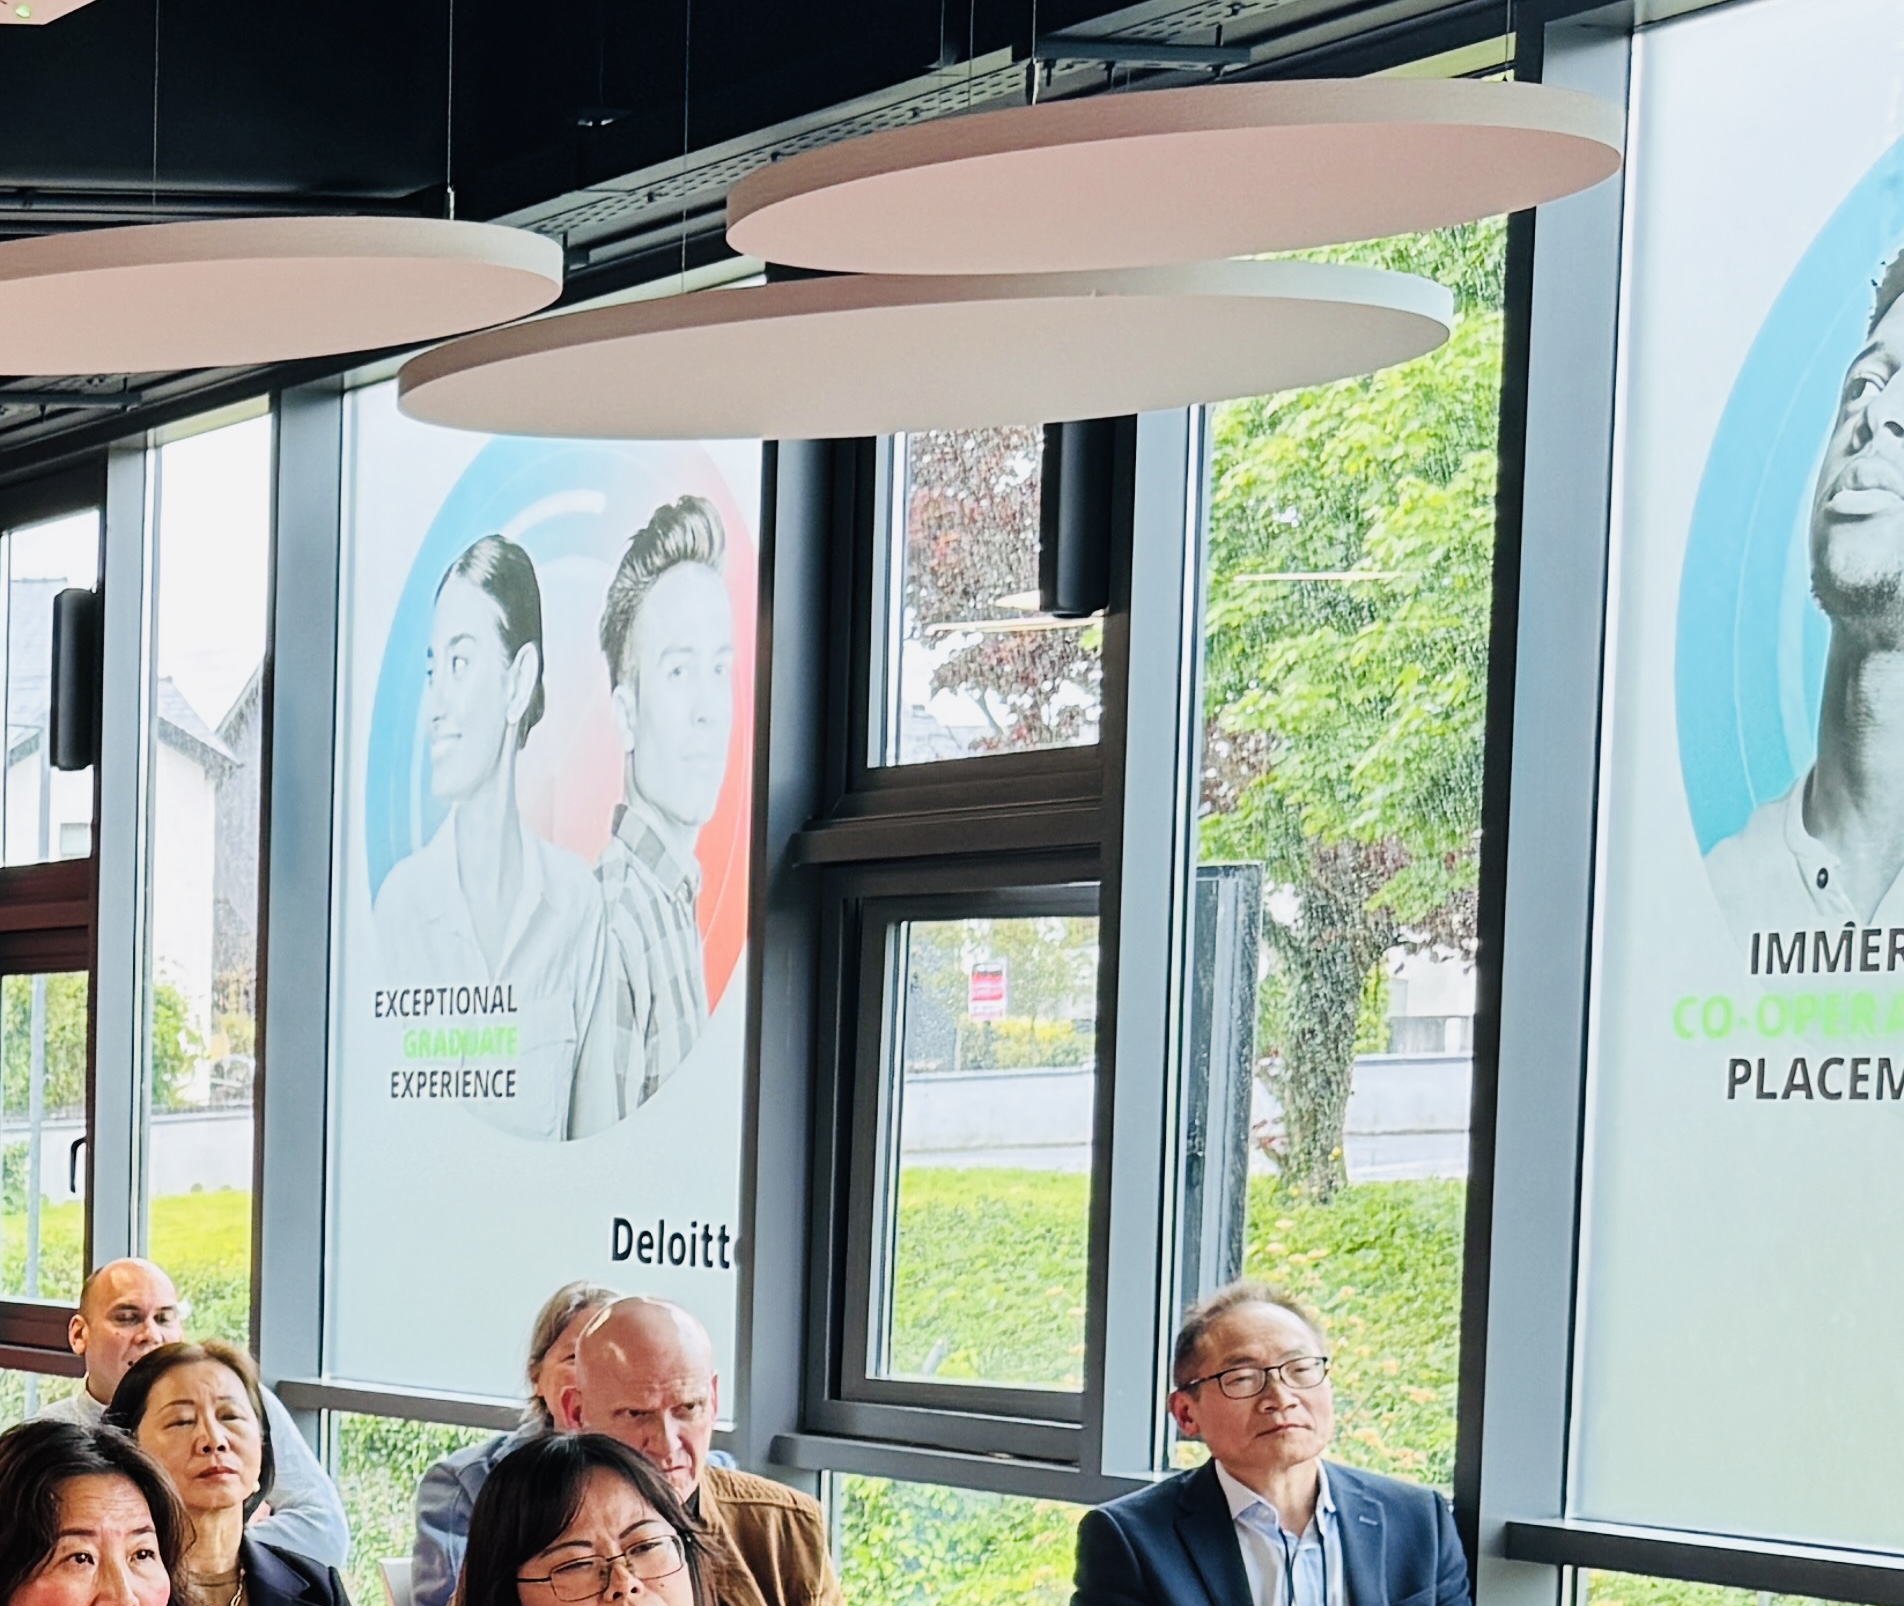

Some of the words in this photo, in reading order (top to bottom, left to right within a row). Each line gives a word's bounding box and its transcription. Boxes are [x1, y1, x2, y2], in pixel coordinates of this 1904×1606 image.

[374, 985, 518, 1018] EXCEPTIONAL
[403, 1026, 518, 1058] GRADUATE
[390, 1069, 517, 1099] EXPERIENCE
[612, 1217, 730, 1270] Deloitt
